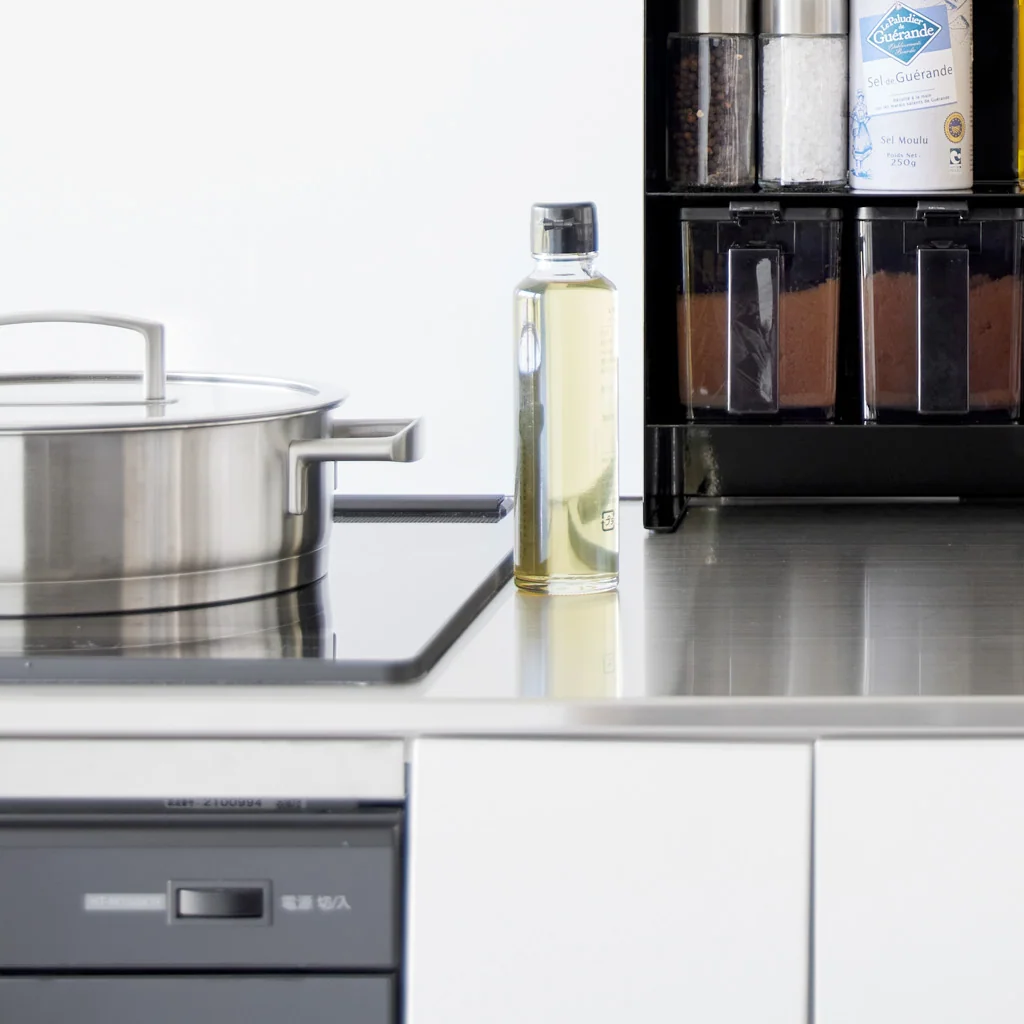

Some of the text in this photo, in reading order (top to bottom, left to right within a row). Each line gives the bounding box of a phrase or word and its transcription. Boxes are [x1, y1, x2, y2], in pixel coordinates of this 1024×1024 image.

[887, 13, 923, 26] Paludier
[873, 23, 935, 44] Guérande
[868, 75, 883, 88] Sel
[896, 64, 953, 83] Guérande
[881, 136, 928, 144] Sel Moulu
[891, 158, 917, 167] 250g
